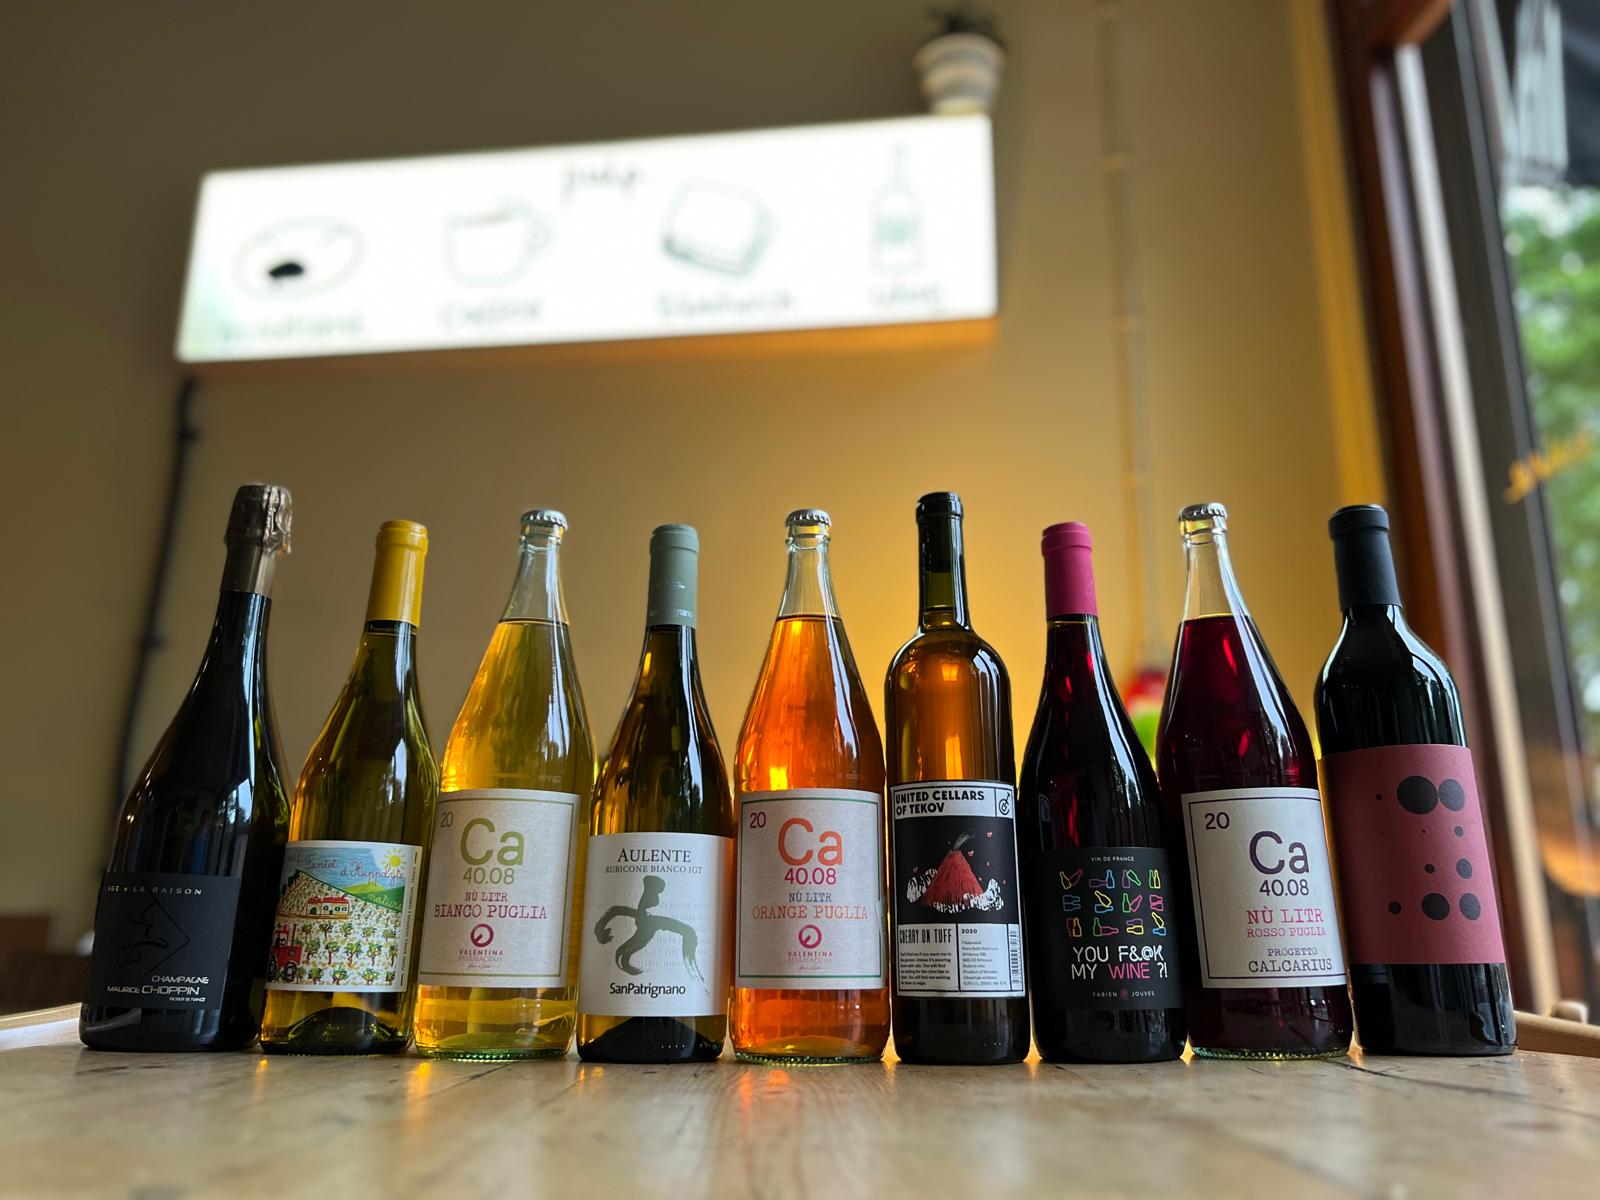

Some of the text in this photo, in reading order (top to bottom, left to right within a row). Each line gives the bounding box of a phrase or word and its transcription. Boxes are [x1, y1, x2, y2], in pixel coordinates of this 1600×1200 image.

[896, 790, 985, 804] UNITED CELLARS
[896, 802, 945, 816] OF TEKOV
[440, 811, 453, 828] 20
[750, 811, 767, 828] 20
[1204, 812, 1230, 830] 20
[460, 817, 525, 866] Ca
[778, 817, 843, 866] Ca
[617, 847, 692, 862] AULENTE
[1249, 830, 1310, 875] Ca
[462, 867, 515, 885] 40.08
[605, 865, 703, 874] RUBICONE BIANCO IGT
[784, 867, 837, 885] 40.08
[153, 886, 202, 895] RAISON
[1259, 878, 1310, 897] 40.08
[481, 892, 508, 902] LITR
[805, 892, 832, 902] LITR
[434, 904, 548, 919] BIANCO PUGLIA
[752, 905, 868, 919] ORANGE PUGLIA
[1246, 905, 1324, 924] NÙ LITR
[921, 928, 931, 944] ON
[934, 928, 952, 944] TUFF
[1246, 926, 1327, 938] ROSSO PUGLIA
[1073, 945, 1164, 963] YOU F&@K
[1267, 947, 1318, 957] PROGETTO
[1071, 963, 1097, 980] MY
[1108, 962, 1151, 980] WINE
[1248, 958, 1333, 973] CALCARIUS
[152, 975, 210, 984] CHAMPAGNE
[107, 985, 200, 995] MAURICE CHOPPIN
[609, 982, 686, 999] SanPatrignano
